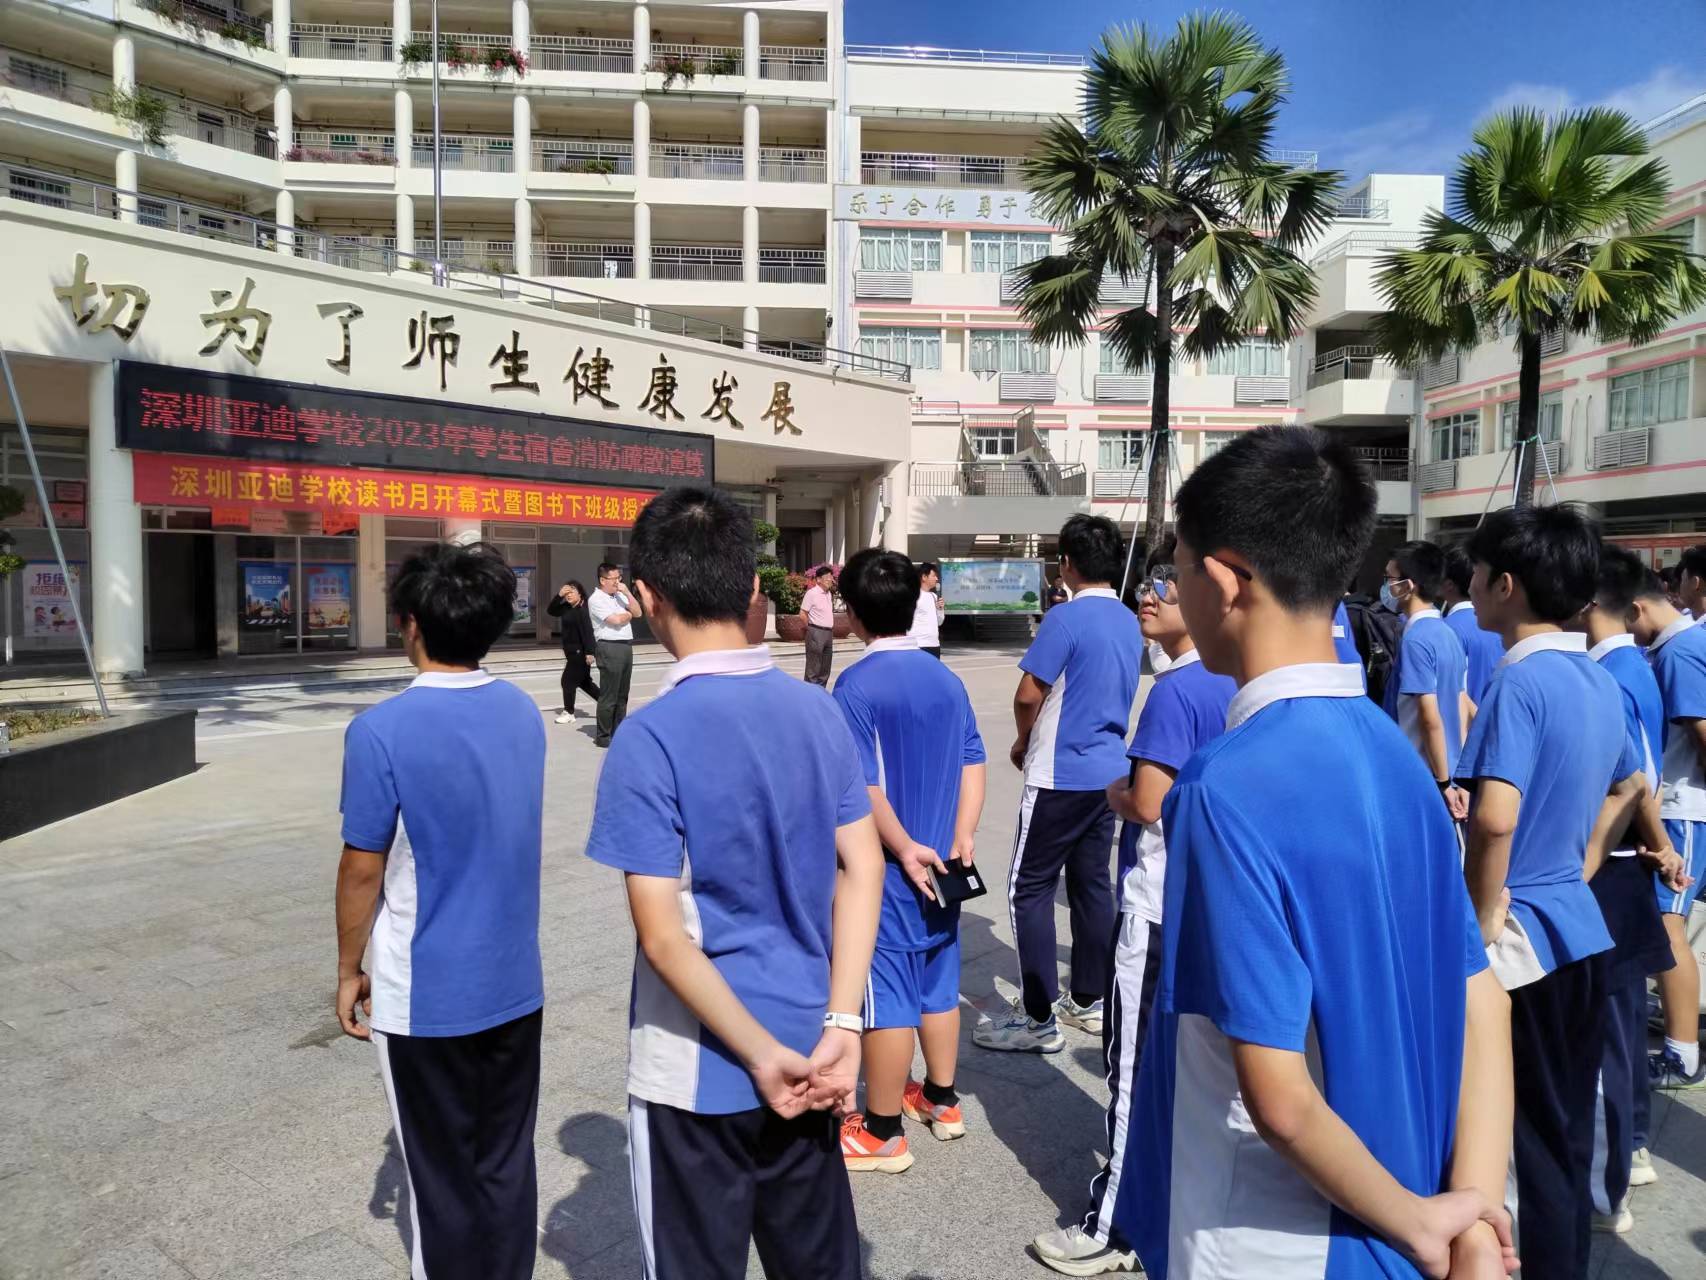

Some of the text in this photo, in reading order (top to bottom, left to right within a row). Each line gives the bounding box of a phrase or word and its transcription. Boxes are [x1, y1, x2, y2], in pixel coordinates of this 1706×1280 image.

[849, 192, 956, 219] 乐于合作
[53, 252, 803, 436] 切为了师生健康发展
[139, 386, 706, 478] 深圳亚迪学校2023年学生宿舍消防疏散演练
[170, 465, 650, 522] 深圳亚迪学校读书月开幕式暨图书下班级授
